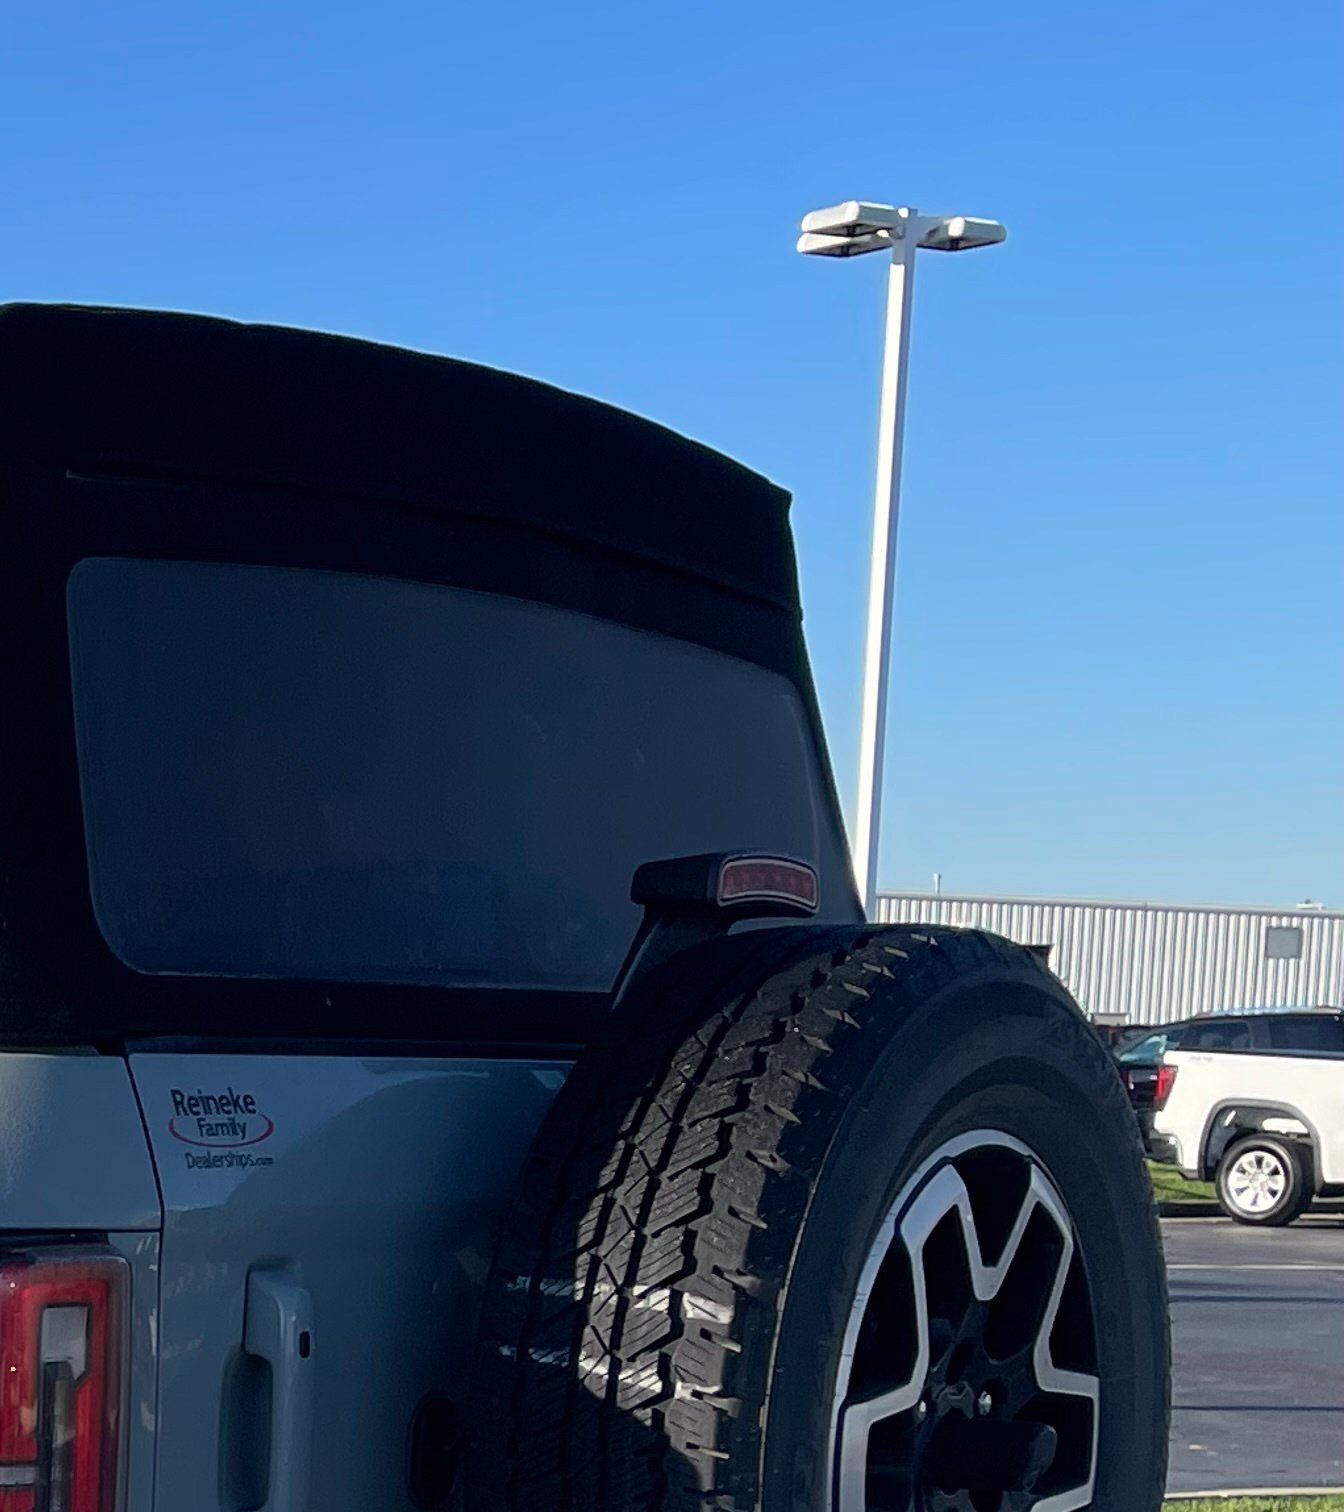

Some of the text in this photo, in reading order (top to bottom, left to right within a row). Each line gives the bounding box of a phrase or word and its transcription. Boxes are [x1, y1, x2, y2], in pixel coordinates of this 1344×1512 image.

[170, 1087, 257, 1117] Reineke
[196, 1117, 247, 1140] Family
[184, 1151, 274, 1169] Dealerships.com
